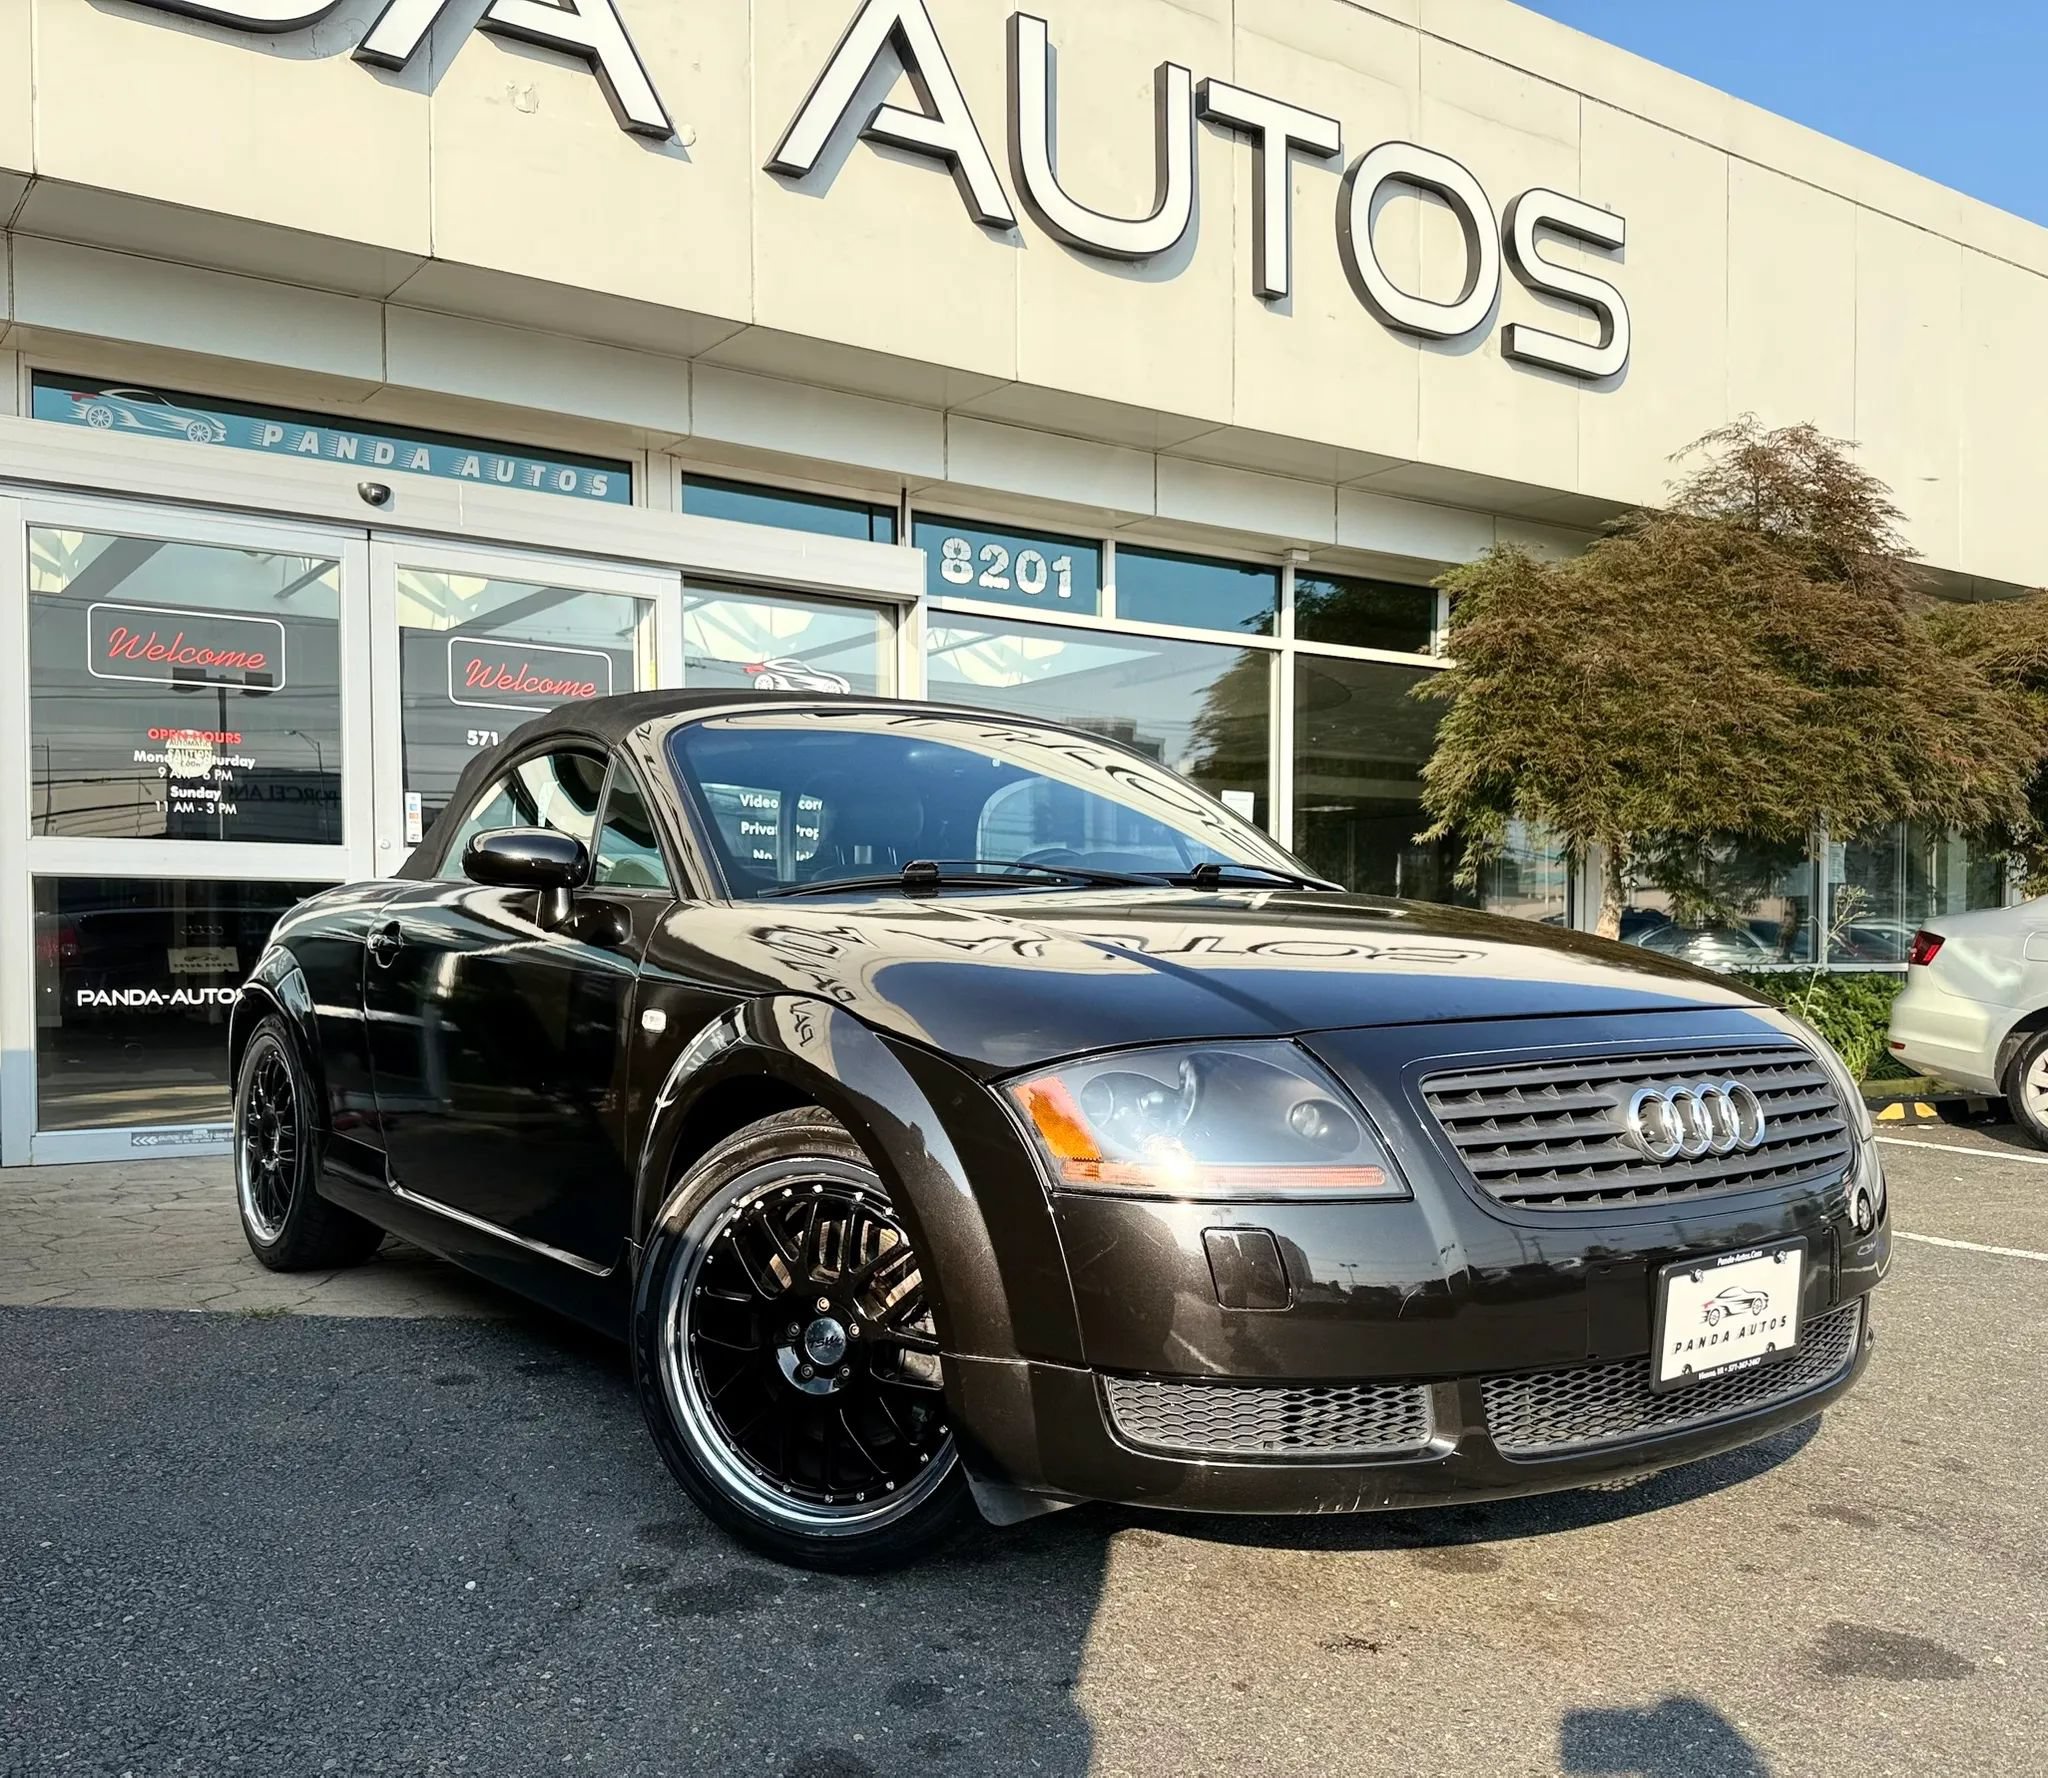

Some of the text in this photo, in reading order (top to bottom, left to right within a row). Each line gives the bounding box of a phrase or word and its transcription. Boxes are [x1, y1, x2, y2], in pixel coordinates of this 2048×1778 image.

[762, 0, 1632, 379] AUTOS
[256, 423, 609, 498] PANDA AUTOS
[940, 537, 1072, 598] 8201
[109, 626, 268, 669] Welcome
[465, 657, 597, 698] Welcome
[466, 730, 499, 746] 571
[158, 766, 167, 778] 9
[214, 769, 233, 781] PM
[170, 785, 221, 801] Sunday
[155, 801, 169, 813] 11
[174, 802, 195, 814] AM
[206, 802, 215, 814] 3
[218, 802, 237, 815] PM
[739, 794, 779, 808] Video
[1673, 1315, 1787, 1355] PANDA AUTOS
